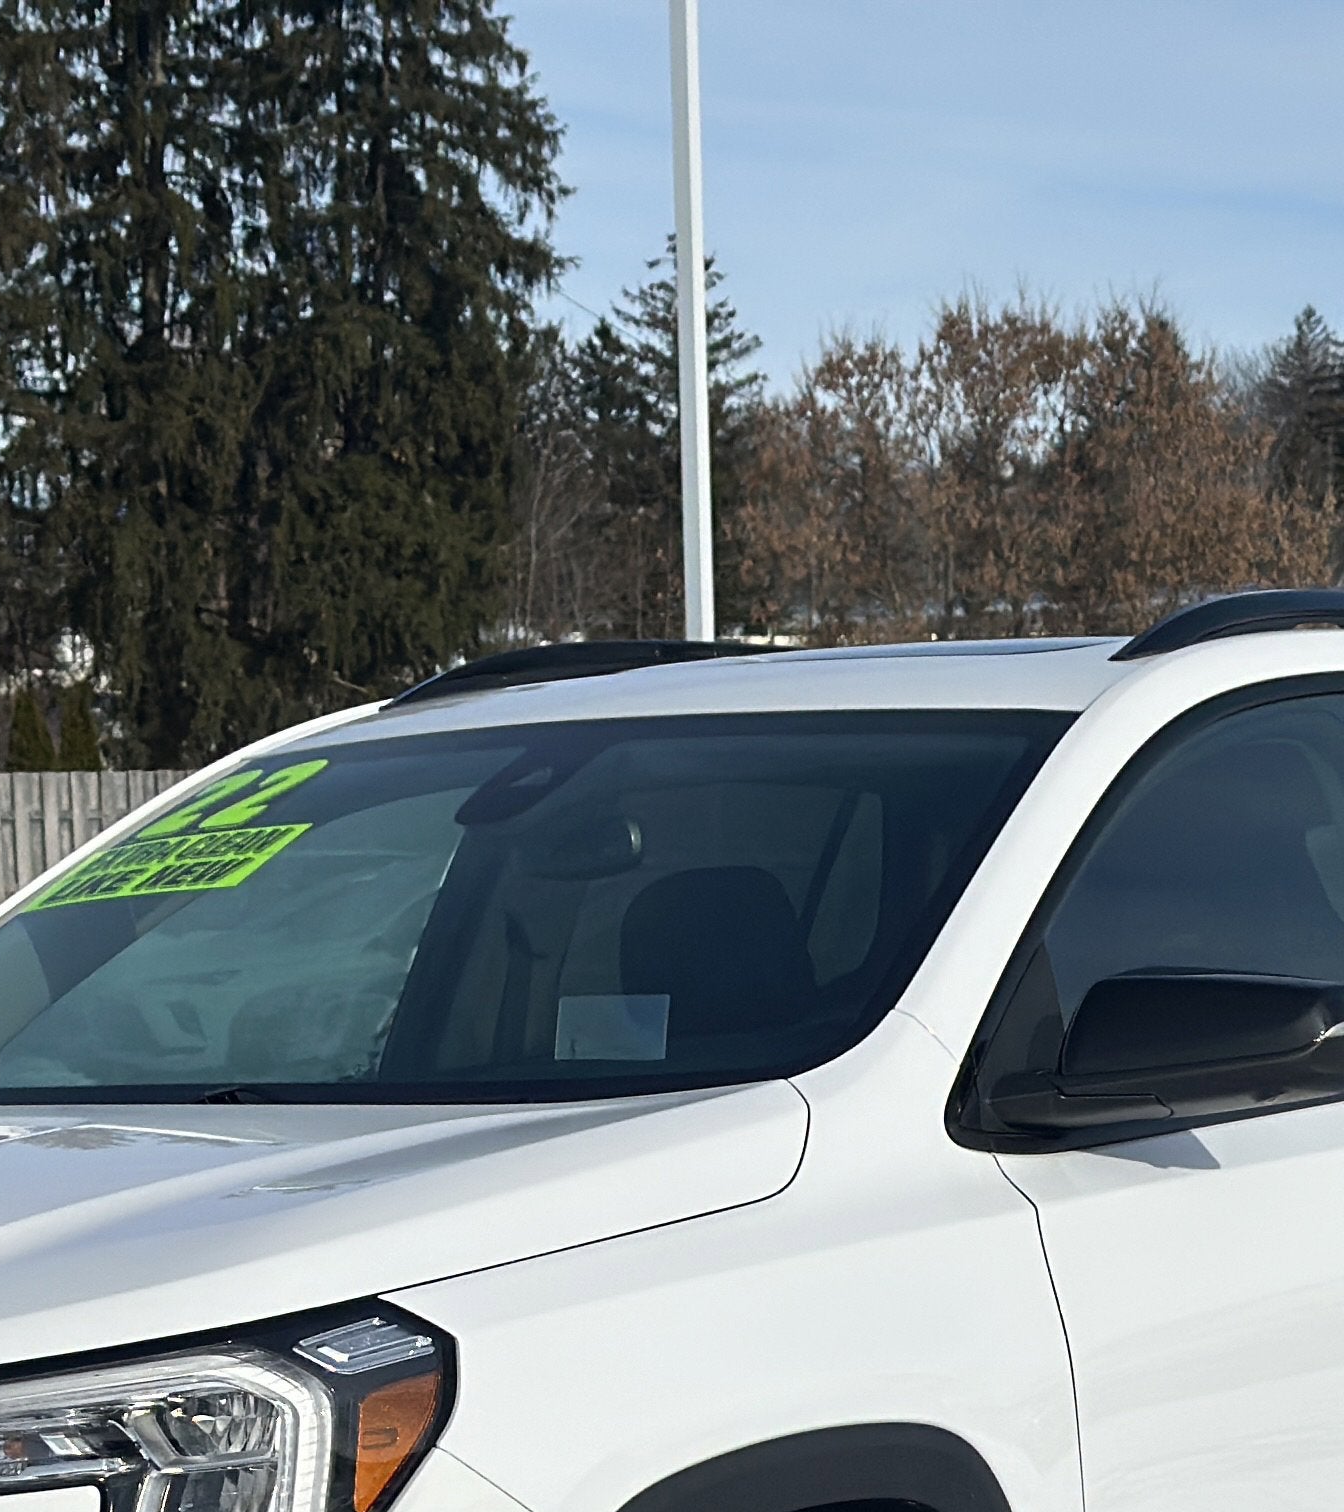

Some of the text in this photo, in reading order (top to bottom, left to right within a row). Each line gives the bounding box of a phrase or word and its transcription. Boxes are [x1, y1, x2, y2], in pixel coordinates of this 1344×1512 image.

[174, 827, 297, 862] CLEAN
[38, 856, 257, 907] LIKE NEW
